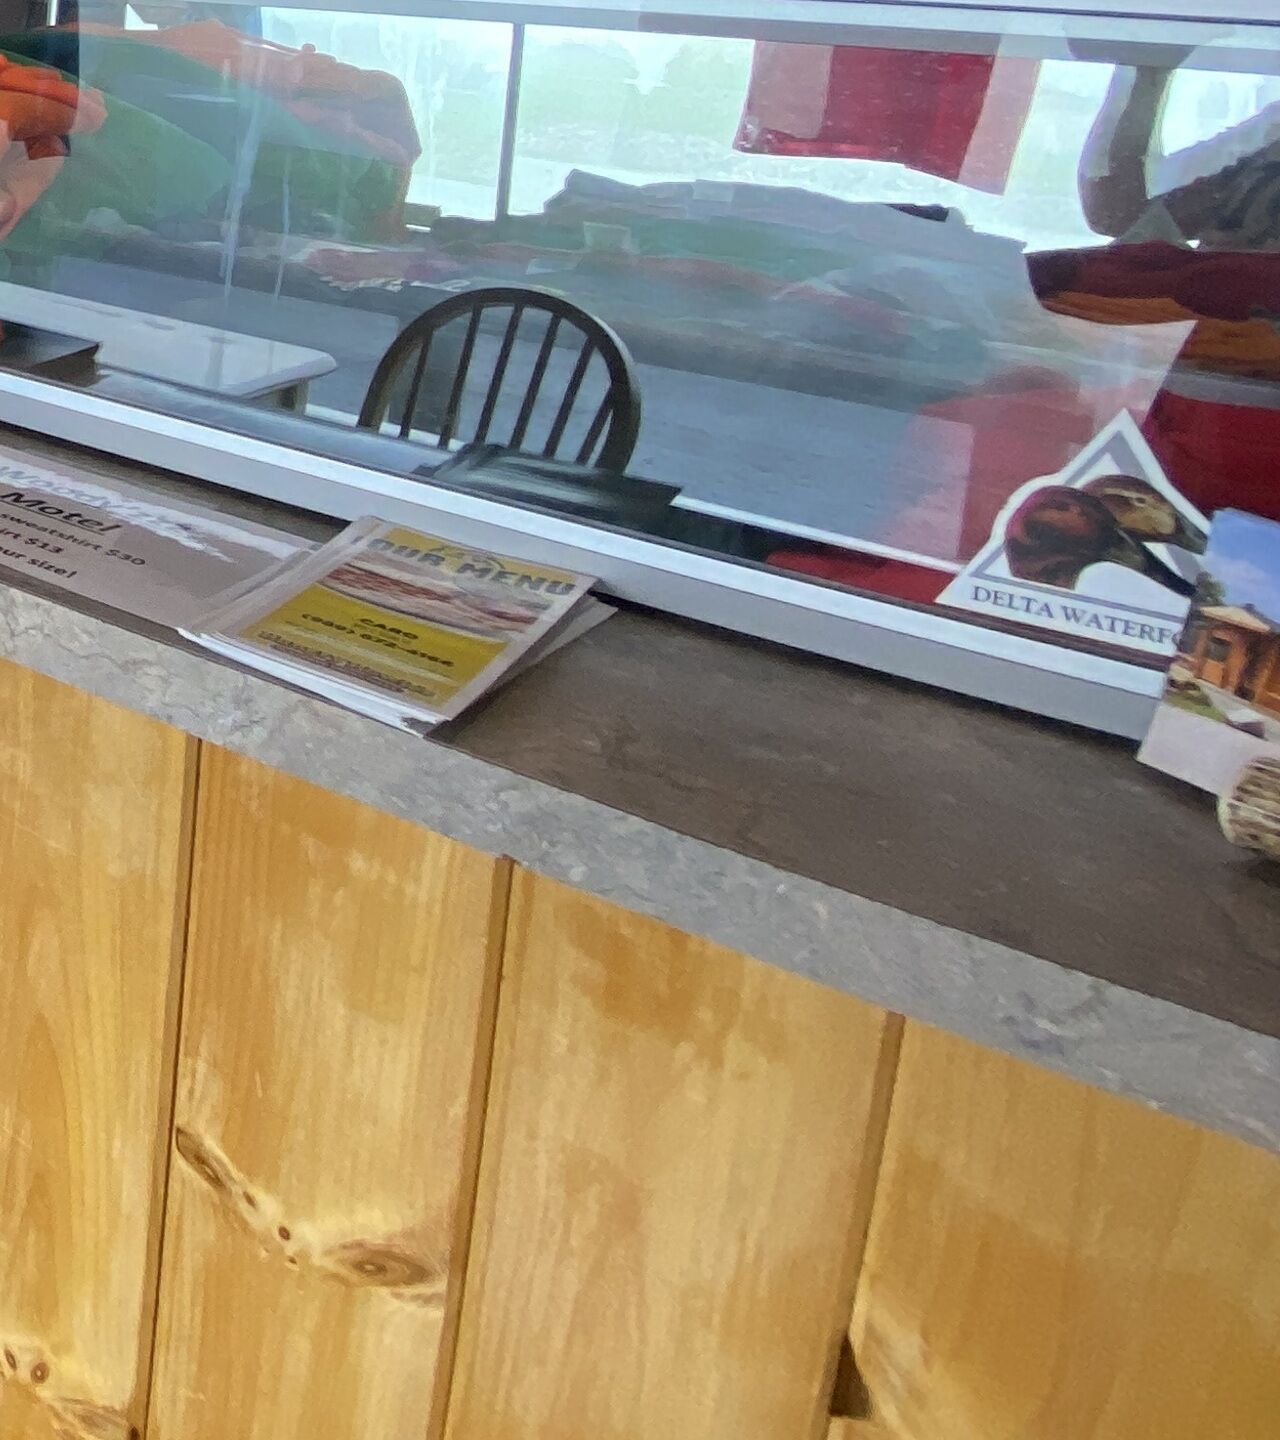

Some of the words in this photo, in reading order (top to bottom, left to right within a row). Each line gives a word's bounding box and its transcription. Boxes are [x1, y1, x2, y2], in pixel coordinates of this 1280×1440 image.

[0, 492, 123, 532] Motel
[0, 513, 102, 550] sweatshirt
[105, 549, 146, 566] $30
[24, 537, 64, 554] $13
[27, 558, 78, 578] size!
[456, 562, 577, 596] MENU
[972, 585, 1054, 620] DELTA
